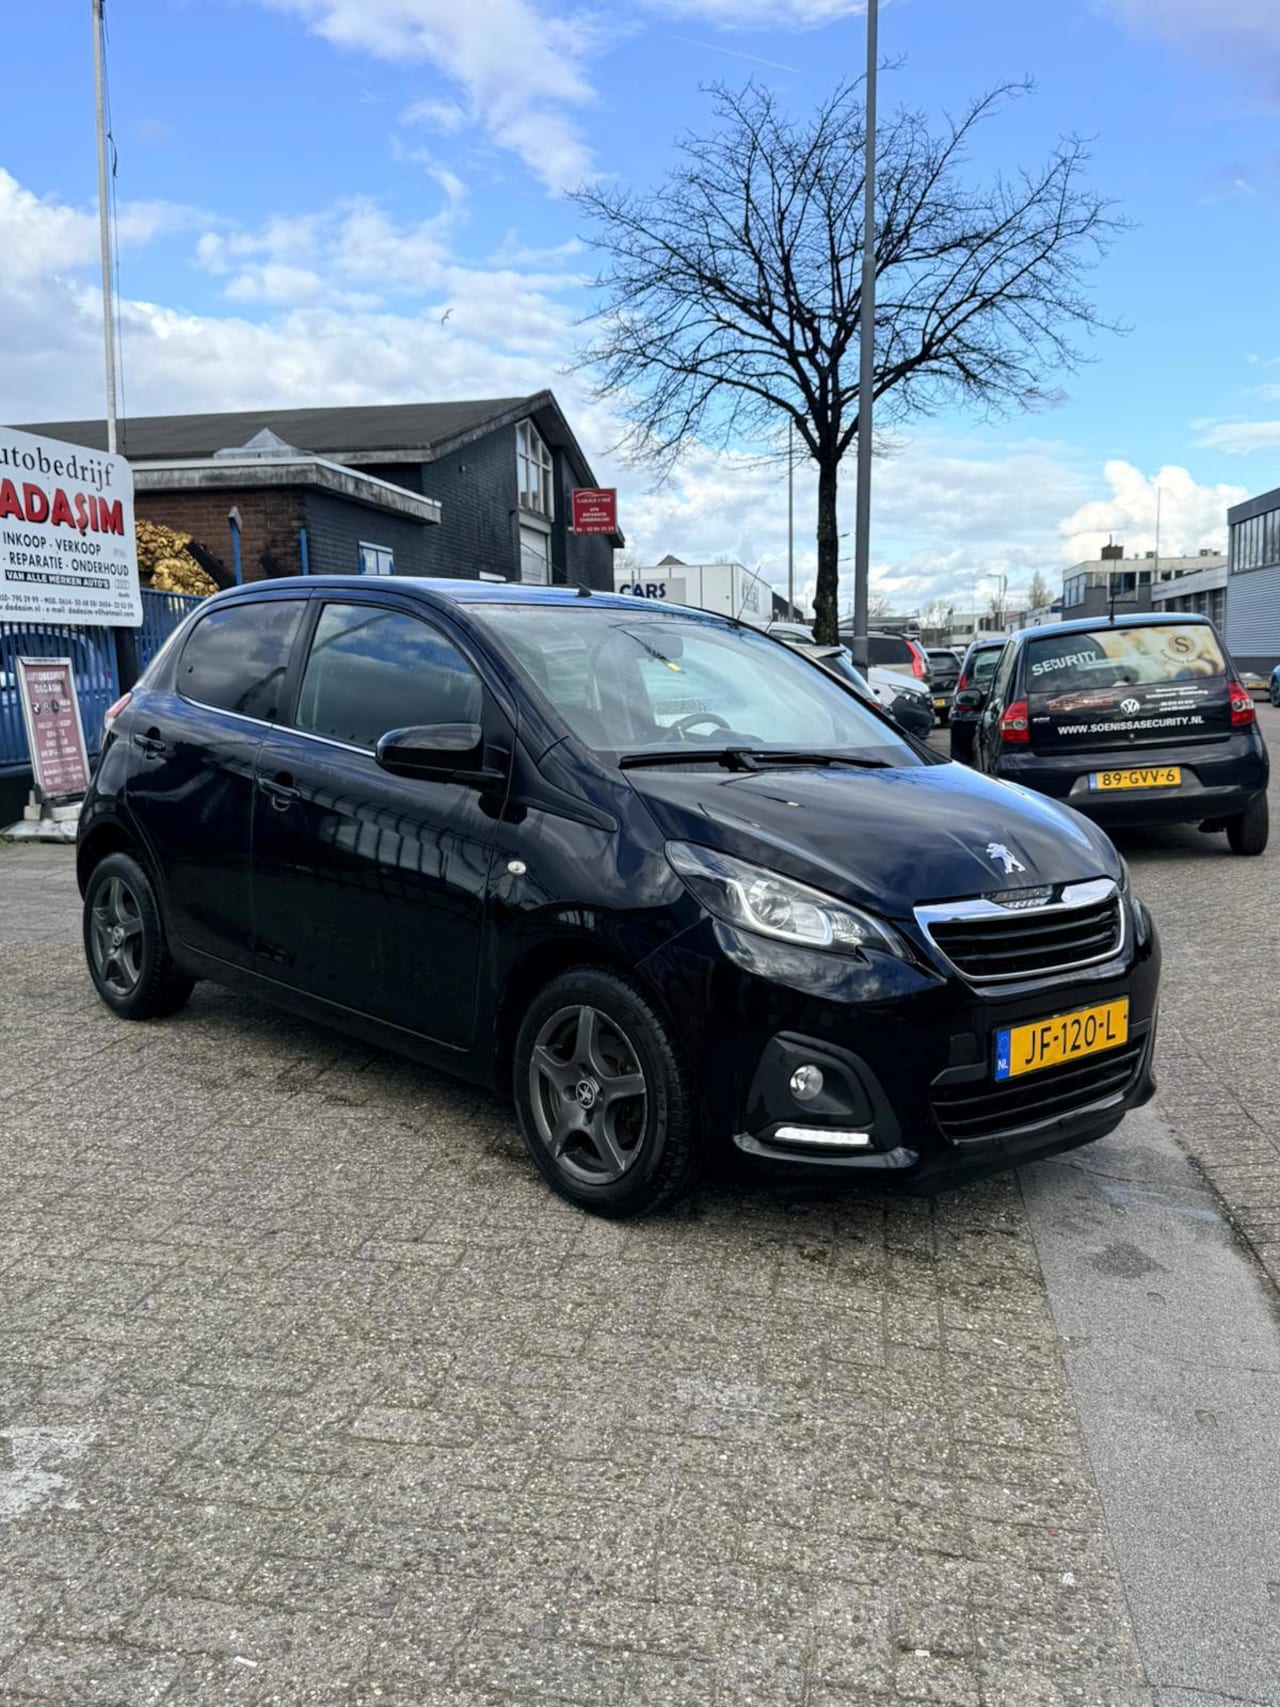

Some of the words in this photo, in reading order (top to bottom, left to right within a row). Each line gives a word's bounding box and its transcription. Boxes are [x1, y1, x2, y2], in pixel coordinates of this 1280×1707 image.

[3, 531, 47, 549] INKOOP
[55, 539, 101, 556] VERKOOP
[9, 552, 63, 570] REPARATIE
[71, 559, 129, 576] ONDERHOUD
[7, 571, 25, 581] VAN
[26, 573, 48, 583] ALLE
[49, 575, 82, 586] MERKEN
[619, 583, 667, 598] CARS
[1174, 636, 1190, 652] S
[1031, 650, 1098, 676] SECURITY
[1057, 716, 1204, 735] WWW.SOENISSASECURITY.NL
[1102, 769, 1176, 787] 89-GVV-6
[1024, 1009, 1116, 1066] JF-120-L
[998, 1058, 1009, 1071] NL
